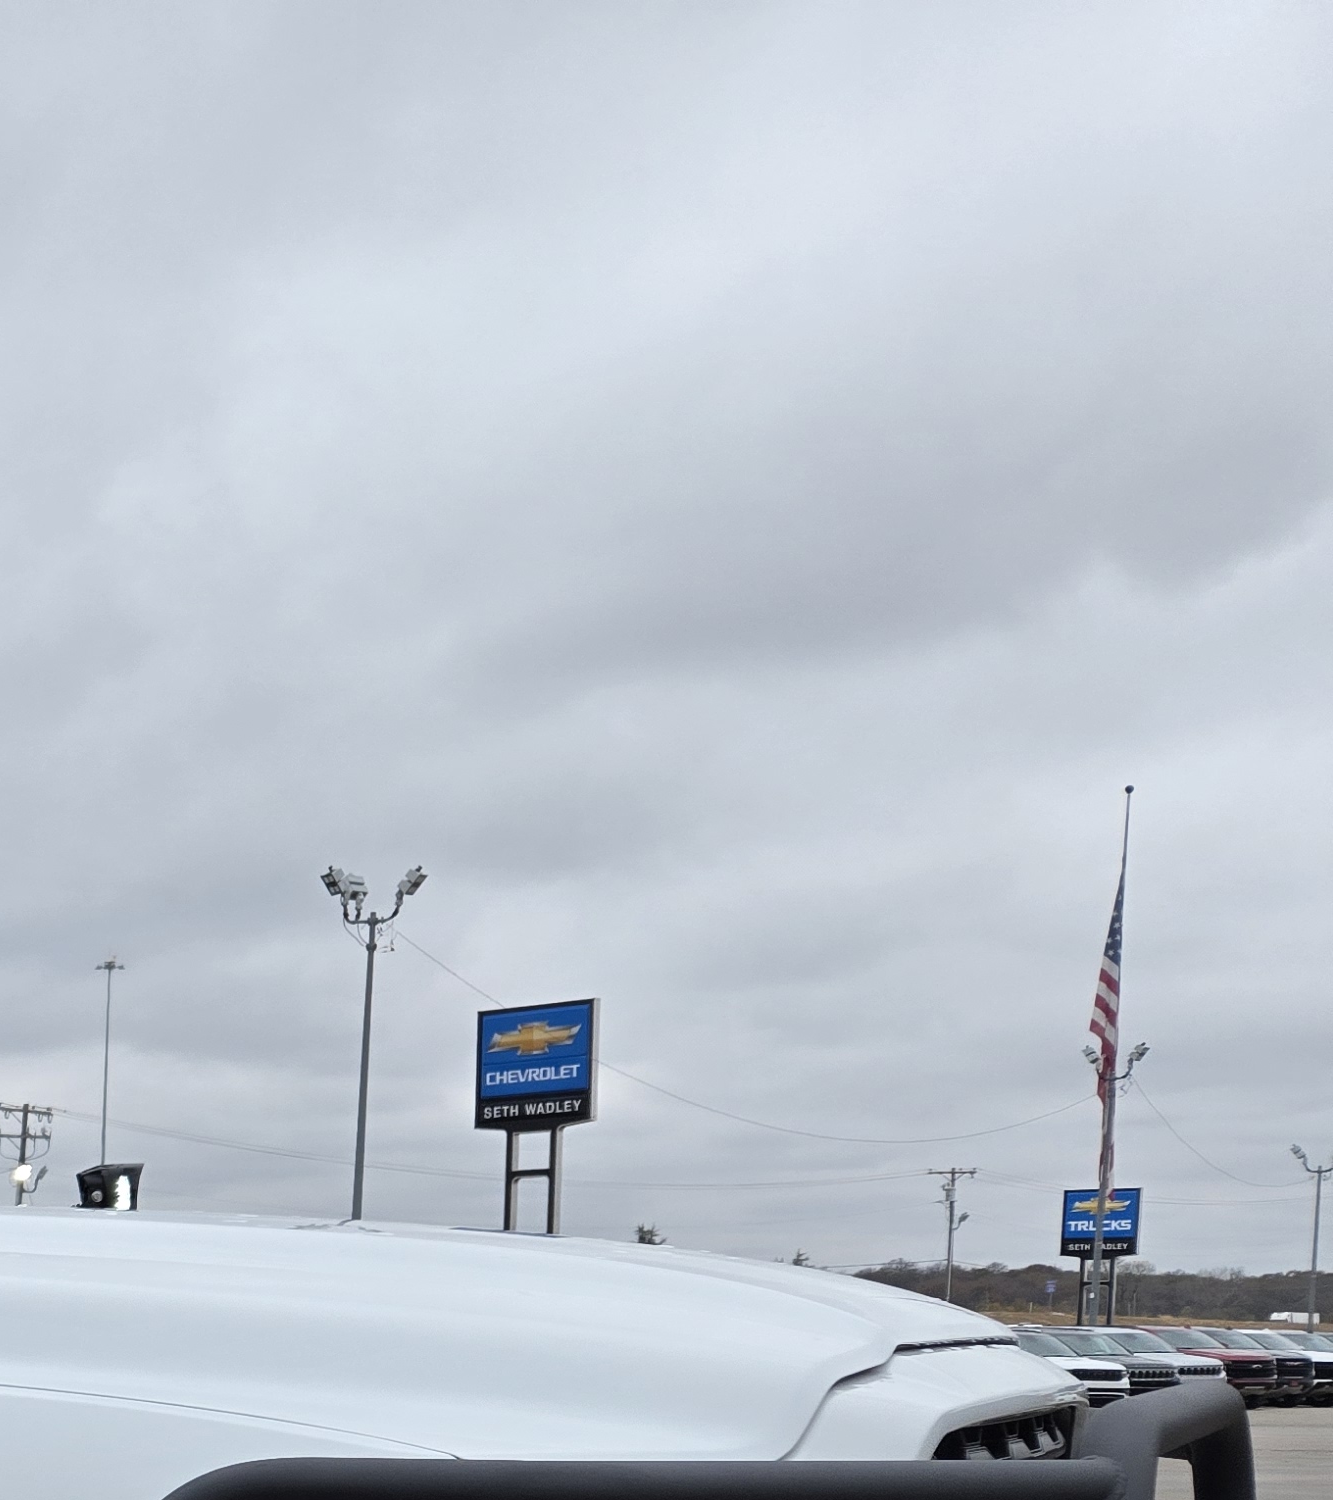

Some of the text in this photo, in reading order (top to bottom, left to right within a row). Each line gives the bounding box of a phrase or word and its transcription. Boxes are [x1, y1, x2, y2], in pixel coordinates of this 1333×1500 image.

[486, 1064, 581, 1086] CHEVROLET
[483, 1099, 582, 1119] SETH WADLEY
[1068, 1242, 1129, 1251] SETH ADLEY
